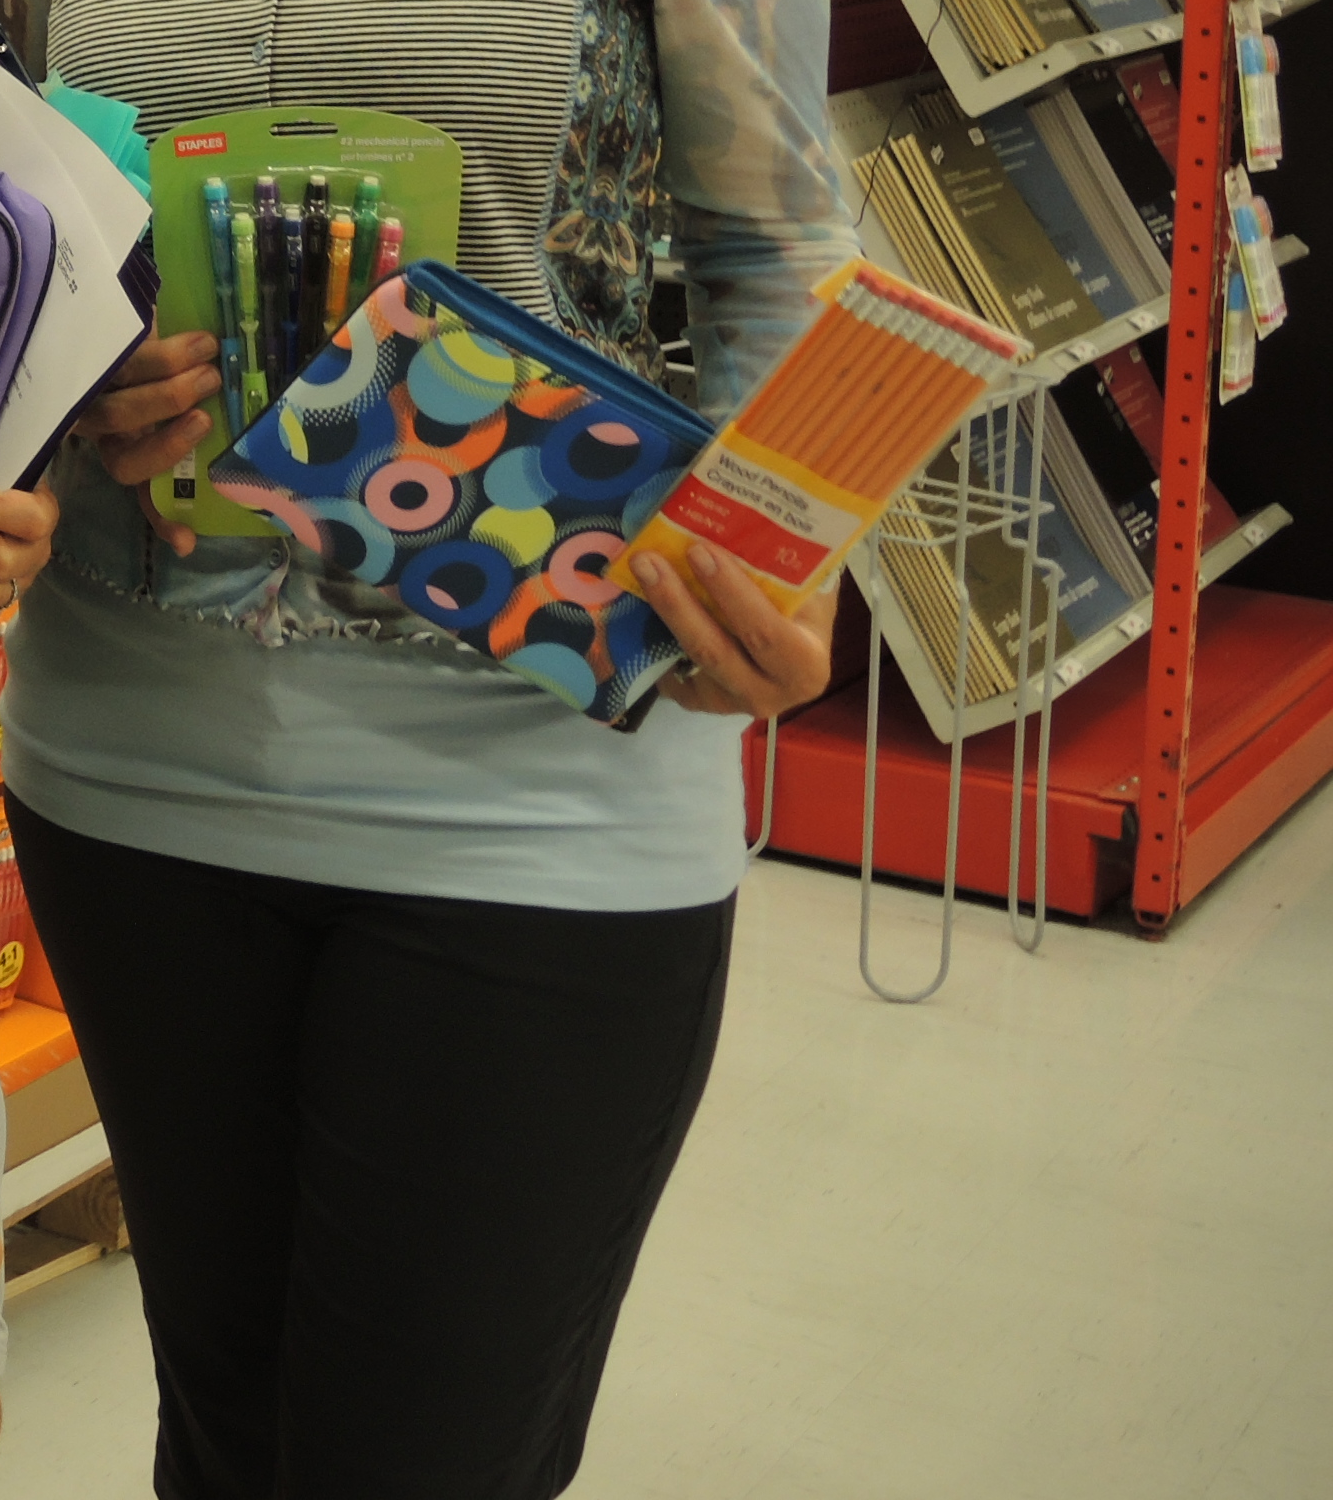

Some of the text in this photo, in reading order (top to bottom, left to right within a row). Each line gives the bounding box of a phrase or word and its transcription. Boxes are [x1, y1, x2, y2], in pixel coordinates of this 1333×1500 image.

[177, 137, 224, 153] STAPLES
[354, 136, 409, 148] mechanical
[410, 136, 446, 149] pencils
[706, 467, 814, 534] Crayons en bois
[718, 453, 810, 512] Wood Pencils
